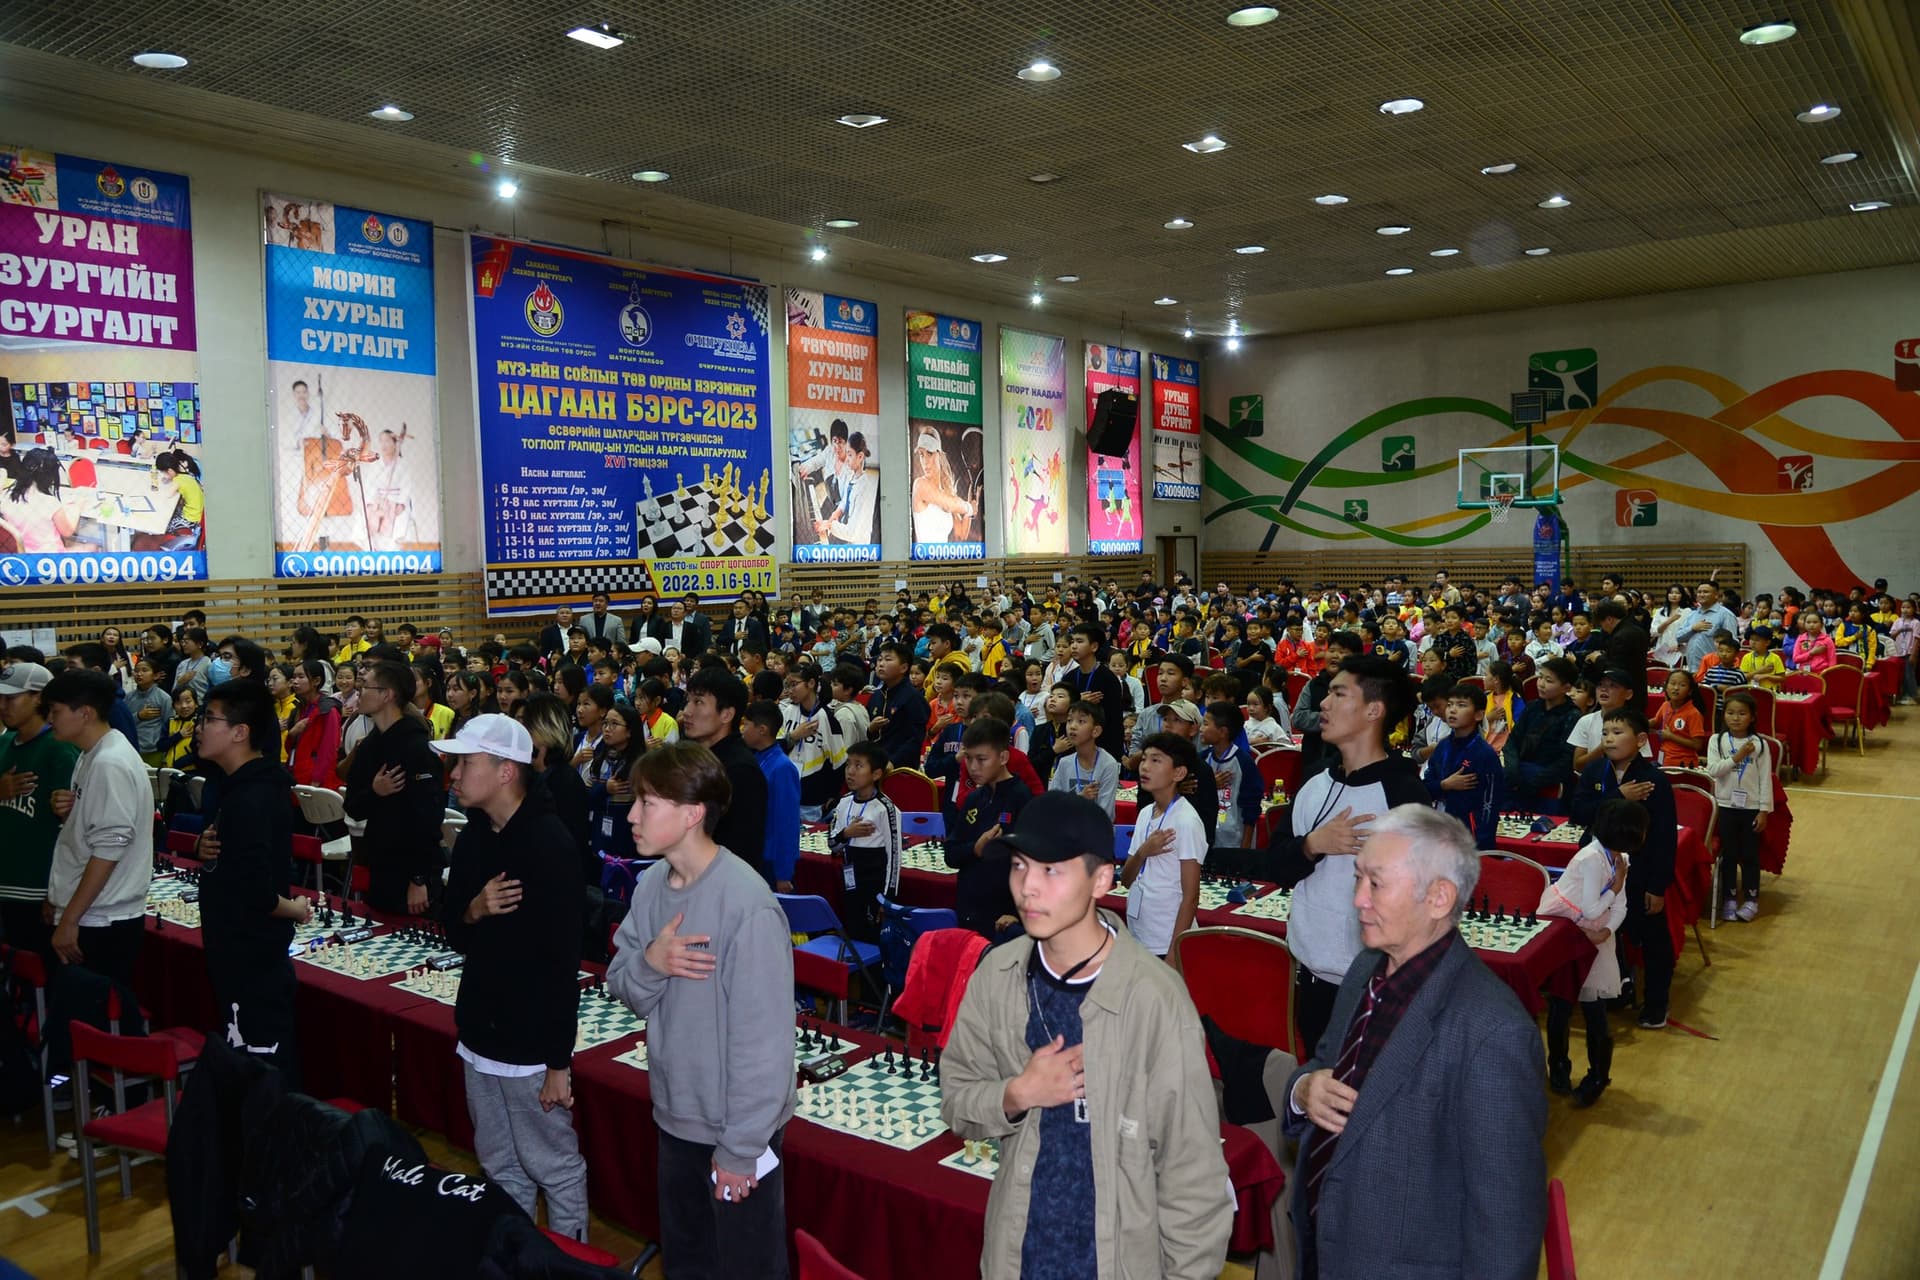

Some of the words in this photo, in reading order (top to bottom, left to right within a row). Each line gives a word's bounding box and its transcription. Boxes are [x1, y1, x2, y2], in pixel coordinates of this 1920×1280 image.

[34, 211, 139, 255] УРАН
[0, 253, 177, 303] ЗУРГИЙН
[312, 266, 396, 298] МОРИН
[0, 299, 178, 344] СУРГАЛТ
[303, 296, 404, 329] ХУУРЫН
[301, 328, 409, 360] СУРГАЛТ
[618, 347, 655, 357] МОНГОЛЫН
[800, 337, 868, 361] ТӨГӨЛДӨР
[608, 354, 637, 364] ШАТРЫН
[638, 357, 665, 366] ХОЛБОО
[923, 356, 970, 377] ТАЛБАЙН
[808, 360, 863, 382] ХУУРЫН
[563, 366, 618, 385] СОЁЛЫН
[622, 370, 647, 387] ТӨВ
[649, 374, 691, 392] ОРДНЫ
[694, 379, 757, 397] НЭРЭМЖИТ
[807, 383, 865, 405] СУРГАЛТ
[1006, 384, 1029, 397] СПОРТ
[1032, 387, 1063, 400] НААДАМ
[1163, 388, 1189, 404] УРТЫН
[499, 383, 617, 419] ЦАГААН
[626, 393, 758, 430] БЭРС-2023
[925, 394, 969, 413] СУРГАЛТ
[1164, 402, 1190, 416] ДУУНЫ
[1017, 405, 1054, 431] 2020
[1161, 414, 1192, 430] СУРГАЛТ
[548, 425, 601, 438] ӨСВӨРИЙН
[603, 428, 659, 442] ШАТАРЧДЫН
[660, 431, 724, 444] ТҮРГЭВЧИЛСЭН
[521, 438, 565, 450] ТОГЛОЛТ
[623, 443, 654, 455] УЛСЫН
[656, 445, 688, 456] АВАРГА
[690, 447, 747, 460] ШАЛГАРУУЛАХ
[604, 455, 626, 468] XVI
[628, 456, 668, 469] ТЭМЦЭЭН
[501, 484, 508, 494] 6
[502, 497, 519, 507] 7-8
[502, 510, 527, 520] 9-10
[504, 523, 534, 533] 11-12
[505, 536, 534, 546] 13-14
[505, 549, 535, 559] 15-18
[812, 546, 878, 562] 90090094
[928, 543, 983, 561] 90090078
[36, 554, 196, 584] 90090094
[312, 554, 434, 577] 90090094
[700, 560, 726, 570] СПОРТ
[727, 559, 770, 569] ЦОГЦОЛБОР
[663, 571, 772, 593] 2022.9.16-9.17
[382, 1156, 425, 1185] Male
[438, 1173, 487, 1202] Cat
